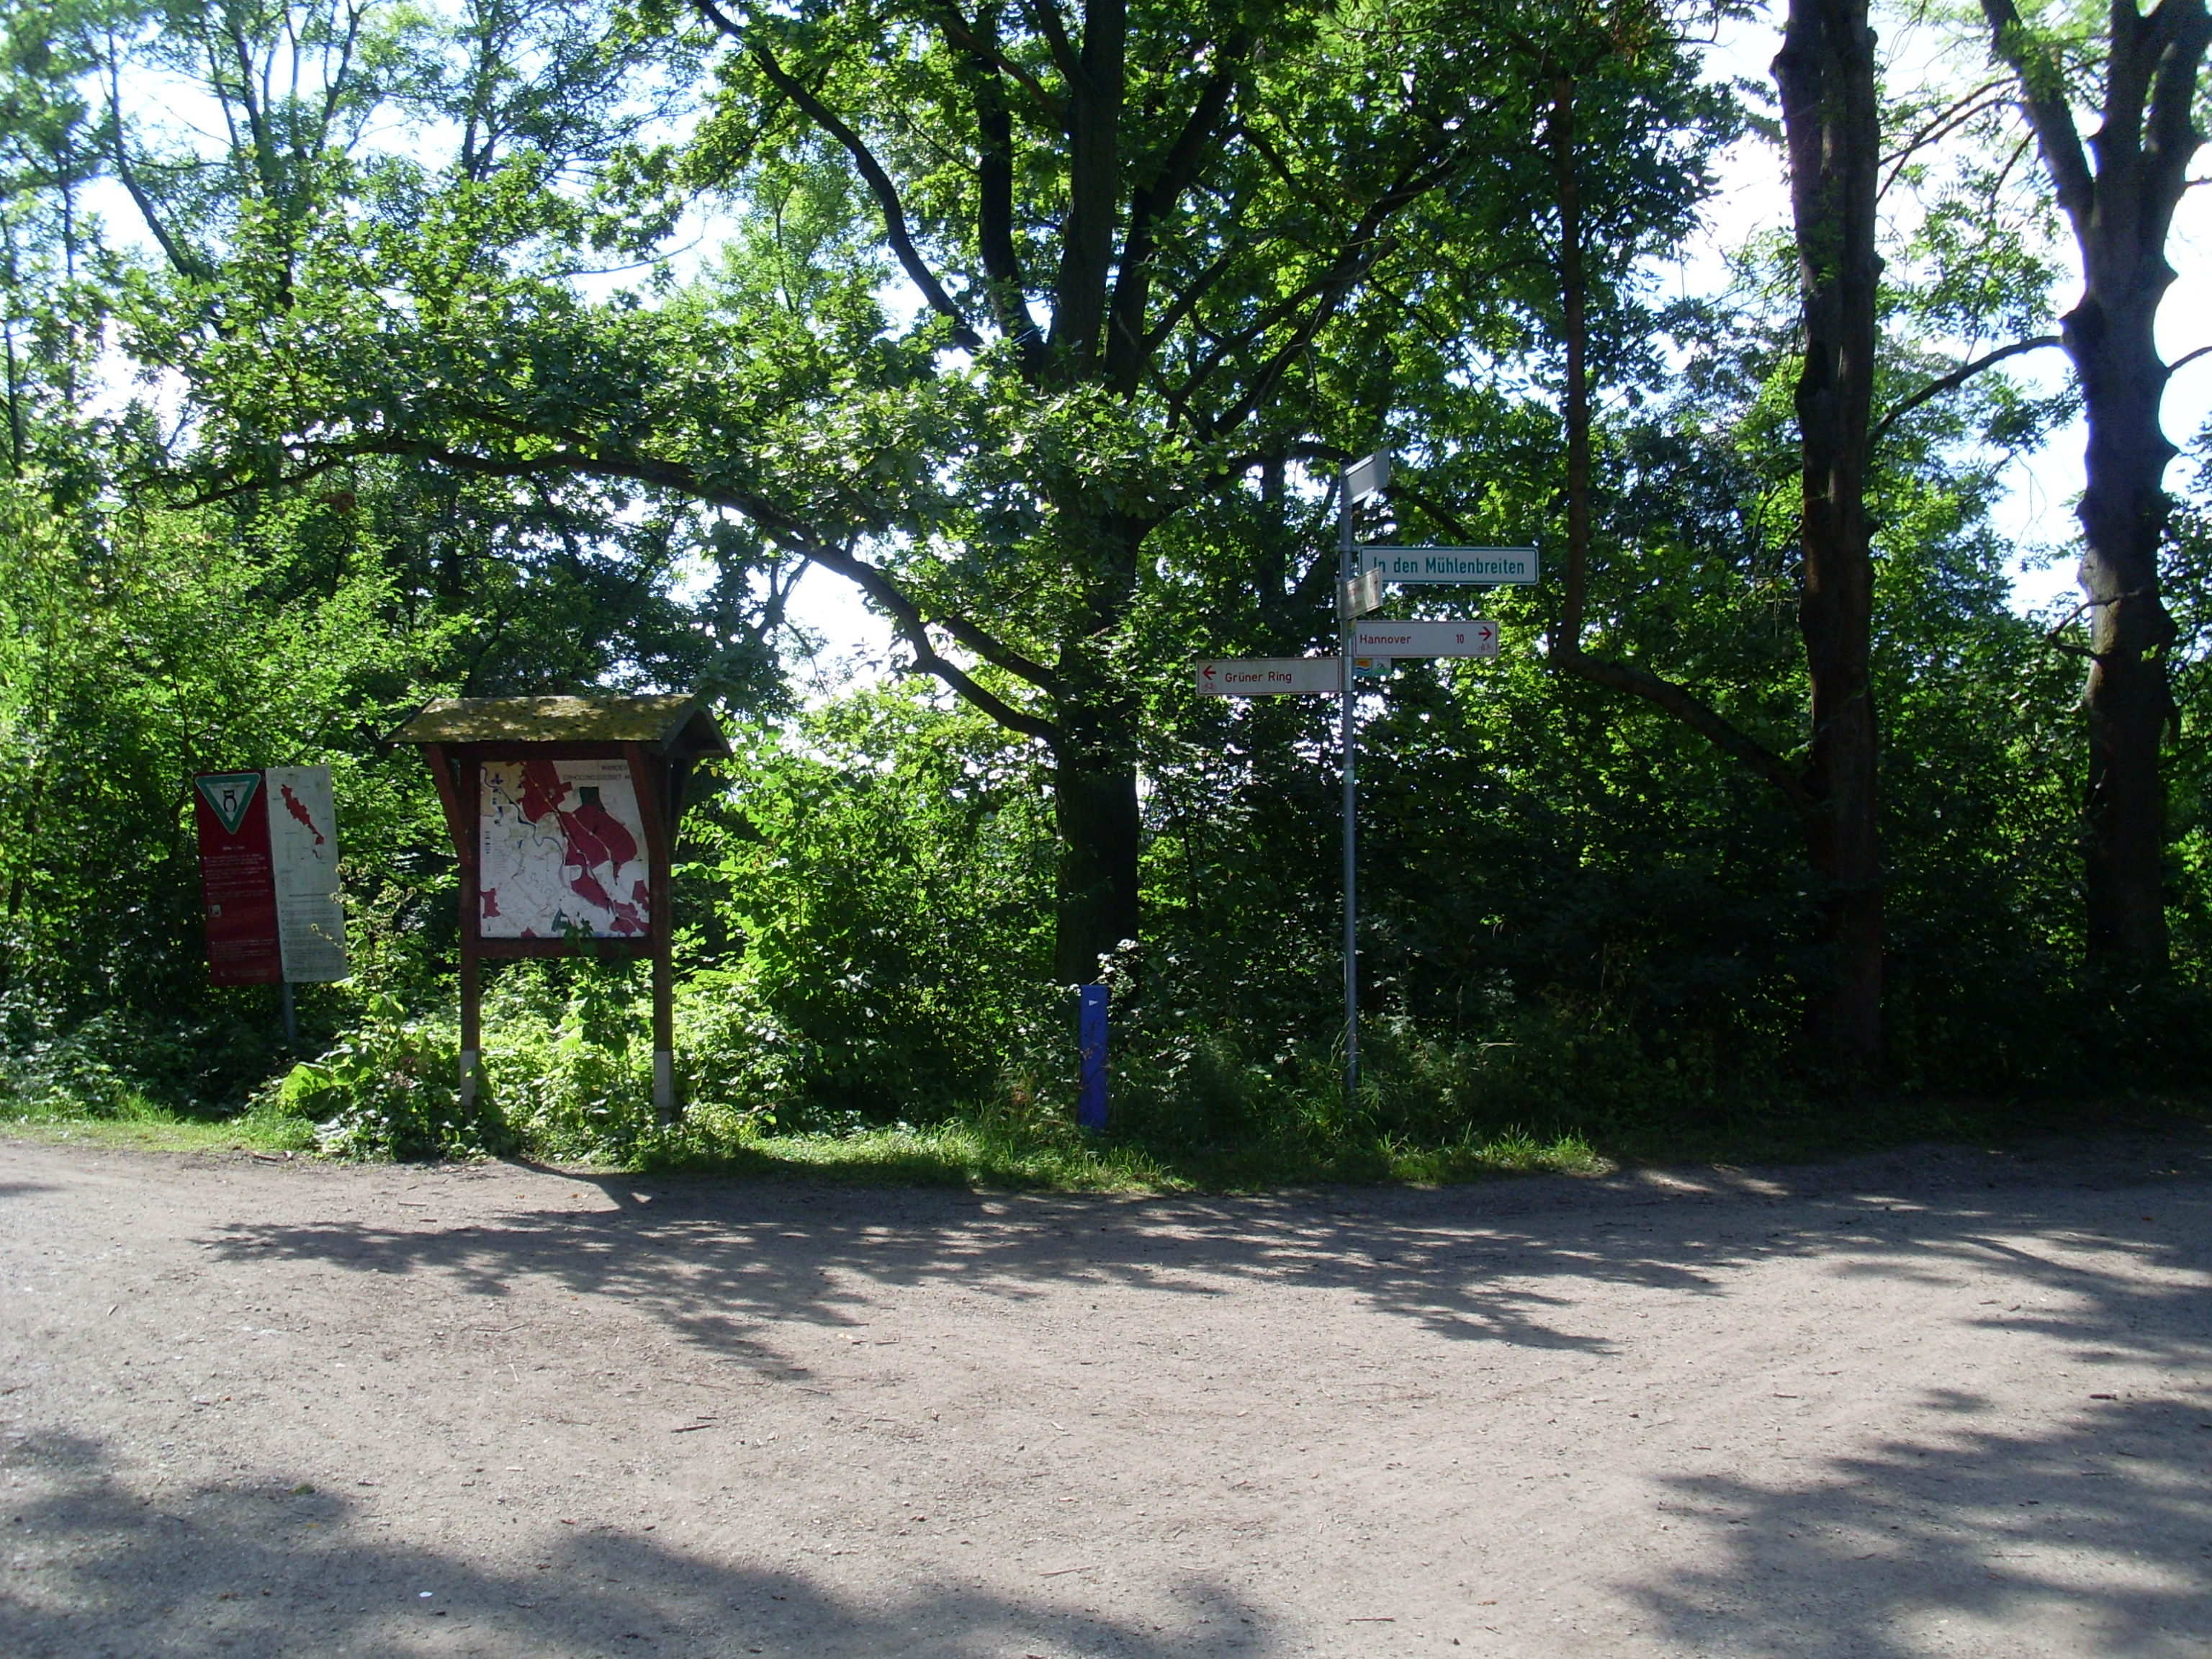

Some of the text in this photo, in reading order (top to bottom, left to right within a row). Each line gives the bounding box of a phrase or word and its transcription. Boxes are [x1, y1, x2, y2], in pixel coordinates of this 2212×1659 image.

[1374, 557, 1524, 574] In den Mühlenbreiten
[1359, 634, 1465, 644] Hannover 10
[1225, 671, 1292, 683] Grüner Ring
